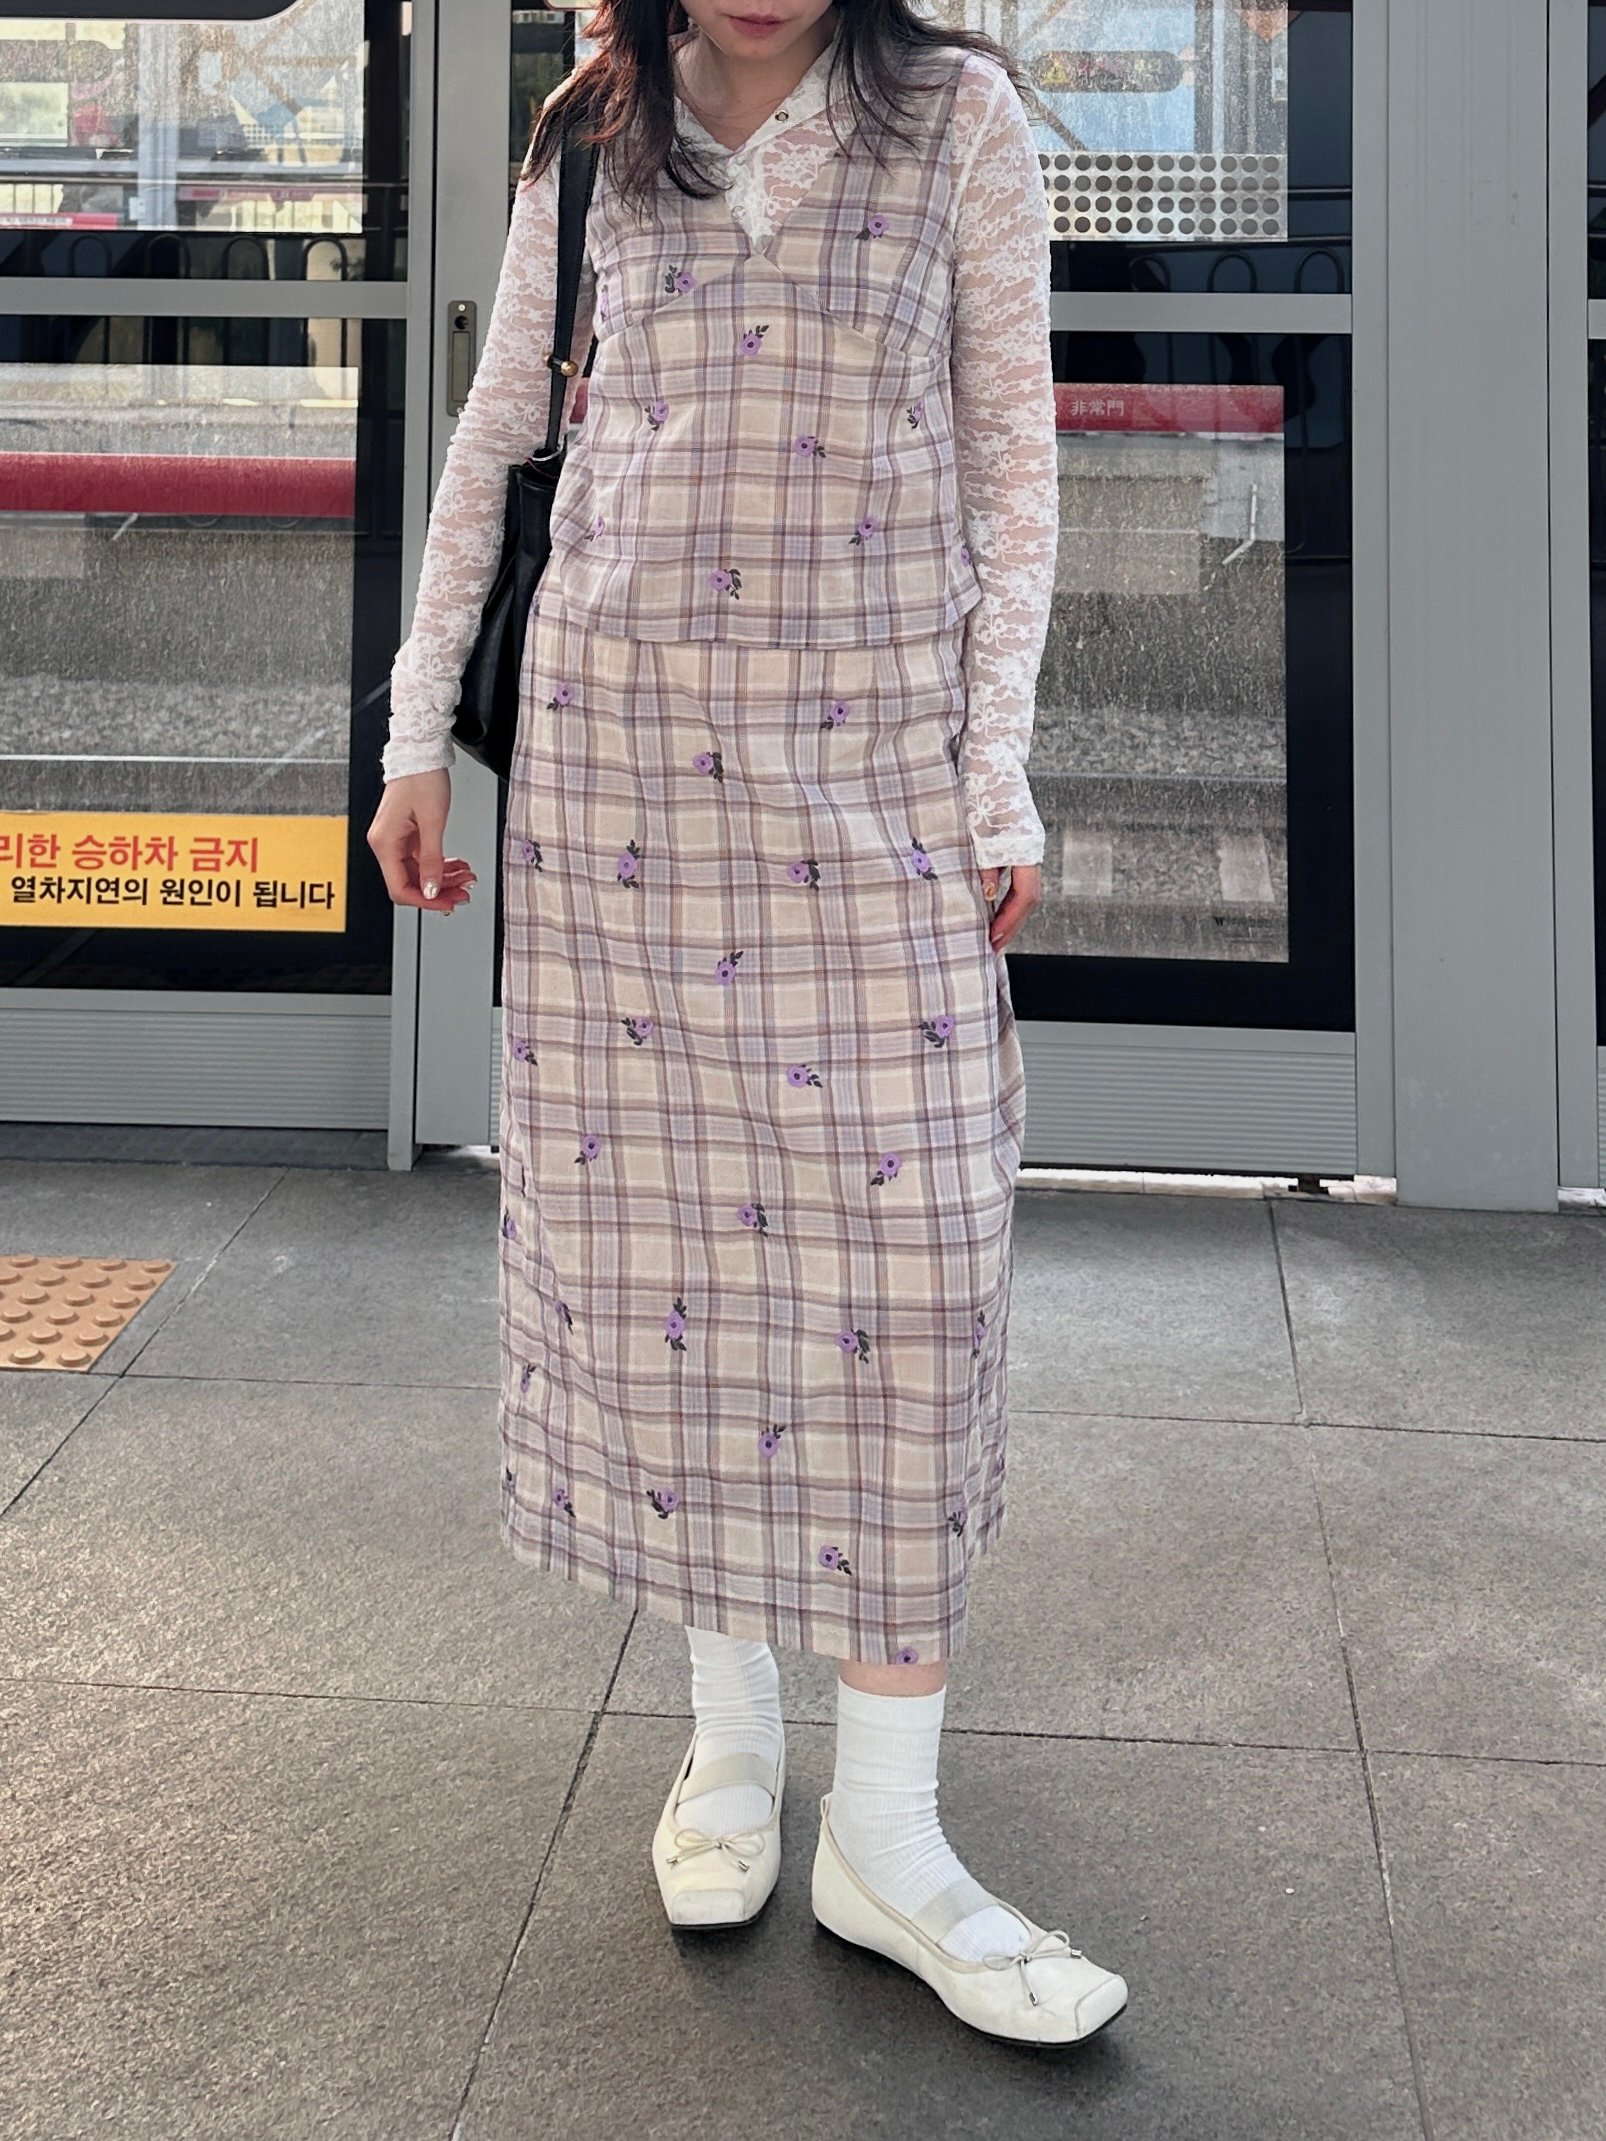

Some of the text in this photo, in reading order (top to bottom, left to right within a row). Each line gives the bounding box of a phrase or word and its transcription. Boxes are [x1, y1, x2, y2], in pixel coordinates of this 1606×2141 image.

[1071, 400, 1124, 416] 非常門
[71, 834, 178, 871] 승하차
[189, 837, 258, 873] 금지
[11, 875, 335, 909] 열차지연의 원인이 됩니다
